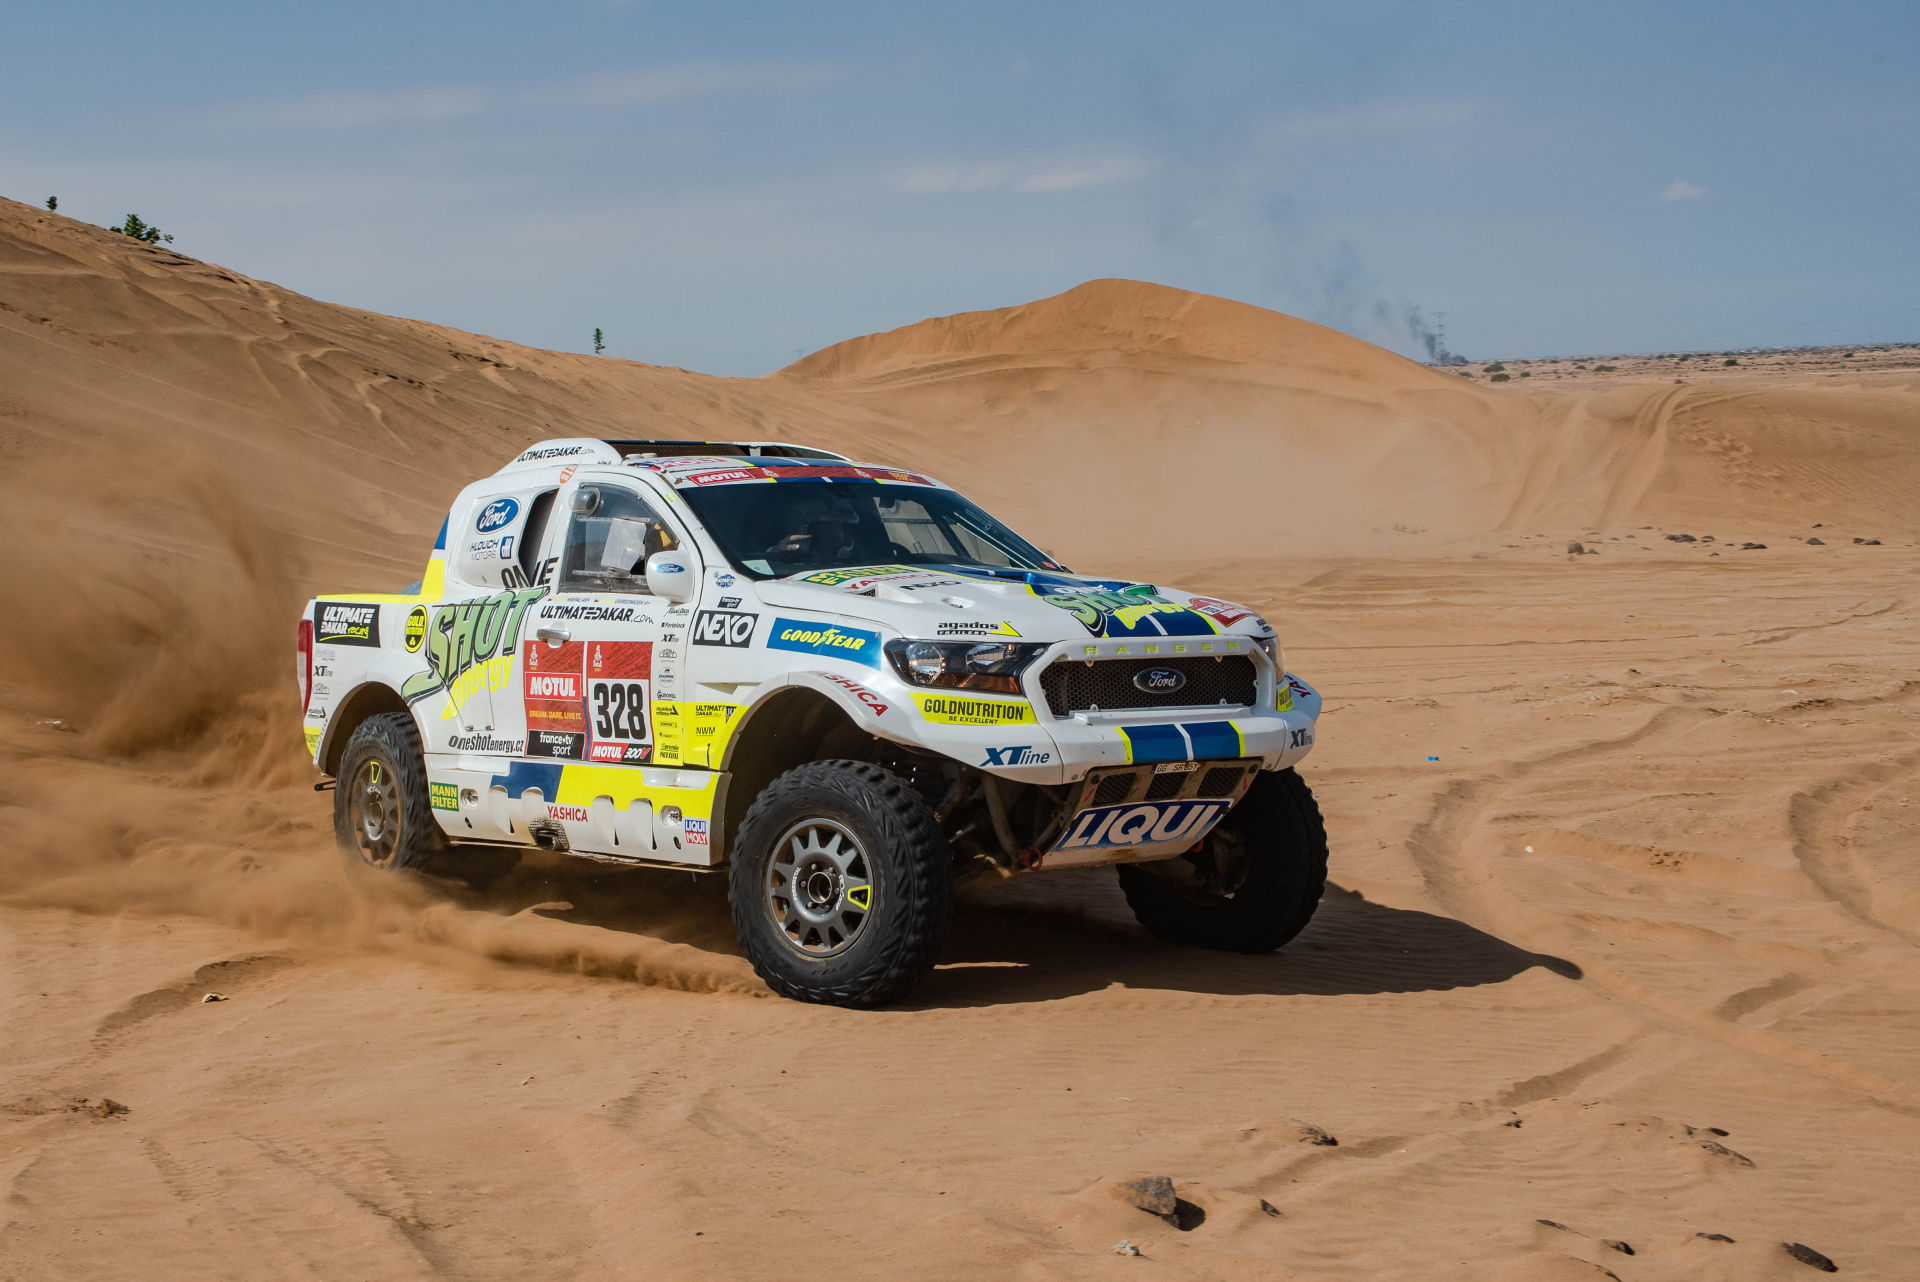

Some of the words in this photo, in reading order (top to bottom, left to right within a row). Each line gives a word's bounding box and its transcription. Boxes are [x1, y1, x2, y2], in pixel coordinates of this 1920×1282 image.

[698, 470, 750, 484] MOTUL
[479, 501, 512, 530] Ford
[501, 556, 559, 588] ONE
[323, 606, 376, 624] ULTIMATE
[407, 615, 425, 627] GOLD
[320, 621, 349, 635] DAKAR
[694, 613, 755, 645] NEXO
[938, 622, 999, 630] agados
[780, 628, 866, 651] GOODYEAR
[401, 586, 550, 711] SHOT
[1085, 641, 1238, 655] RANGER
[441, 654, 514, 720] energy
[530, 676, 576, 697] MOTUL
[1148, 671, 1177, 687] Ford
[594, 683, 647, 740] 328
[959, 715, 999, 725] EXCELLENT
[552, 744, 572, 757] sport
[592, 745, 622, 759] MOTUL
[623, 747, 651, 760] 300V
[979, 745, 1050, 767] XTline
[431, 784, 457, 797] MANN
[431, 797, 458, 810] FILTER
[547, 806, 589, 823] YASHICA
[685, 820, 706, 832] LIQUI
[1061, 804, 1220, 847] LIQUI
[686, 832, 707, 845] MOLY
